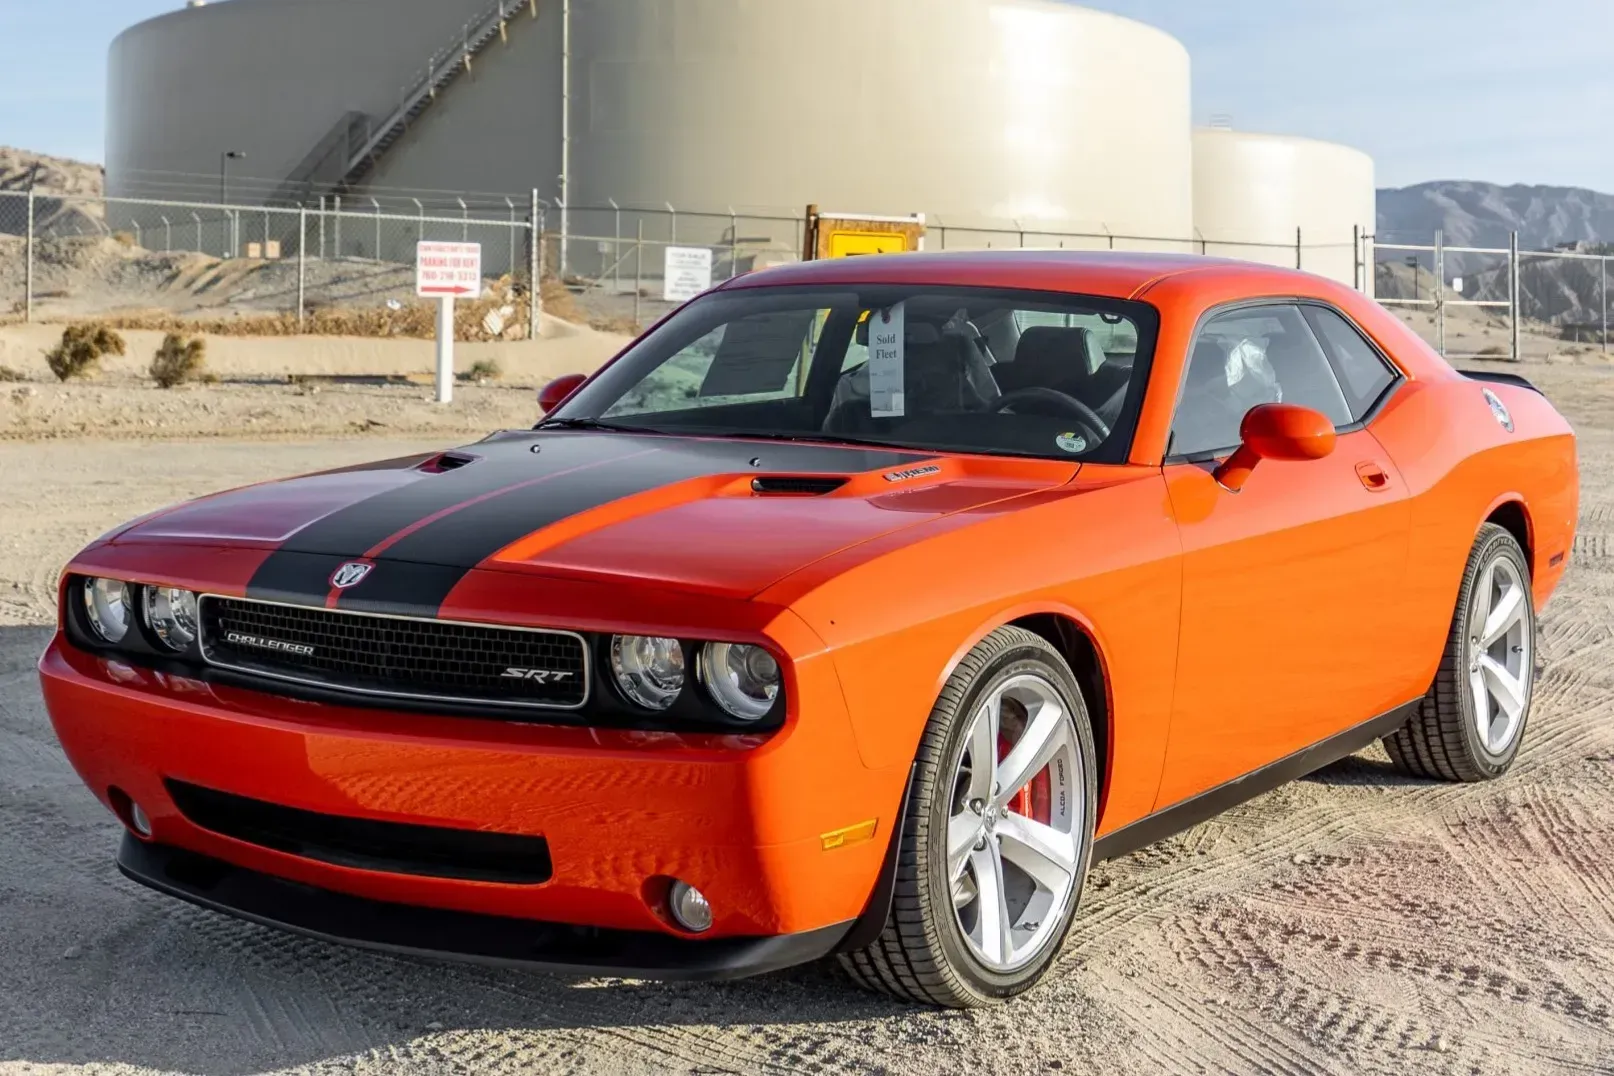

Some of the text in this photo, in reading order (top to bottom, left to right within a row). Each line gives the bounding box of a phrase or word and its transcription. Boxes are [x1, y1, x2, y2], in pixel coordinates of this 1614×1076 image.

[876, 333, 896, 345] Sold
[876, 349, 897, 360] Fleet
[227, 632, 314, 656] CHALLENGER
[500, 667, 574, 684] SRT
[1057, 758, 1065, 786] FORGED
